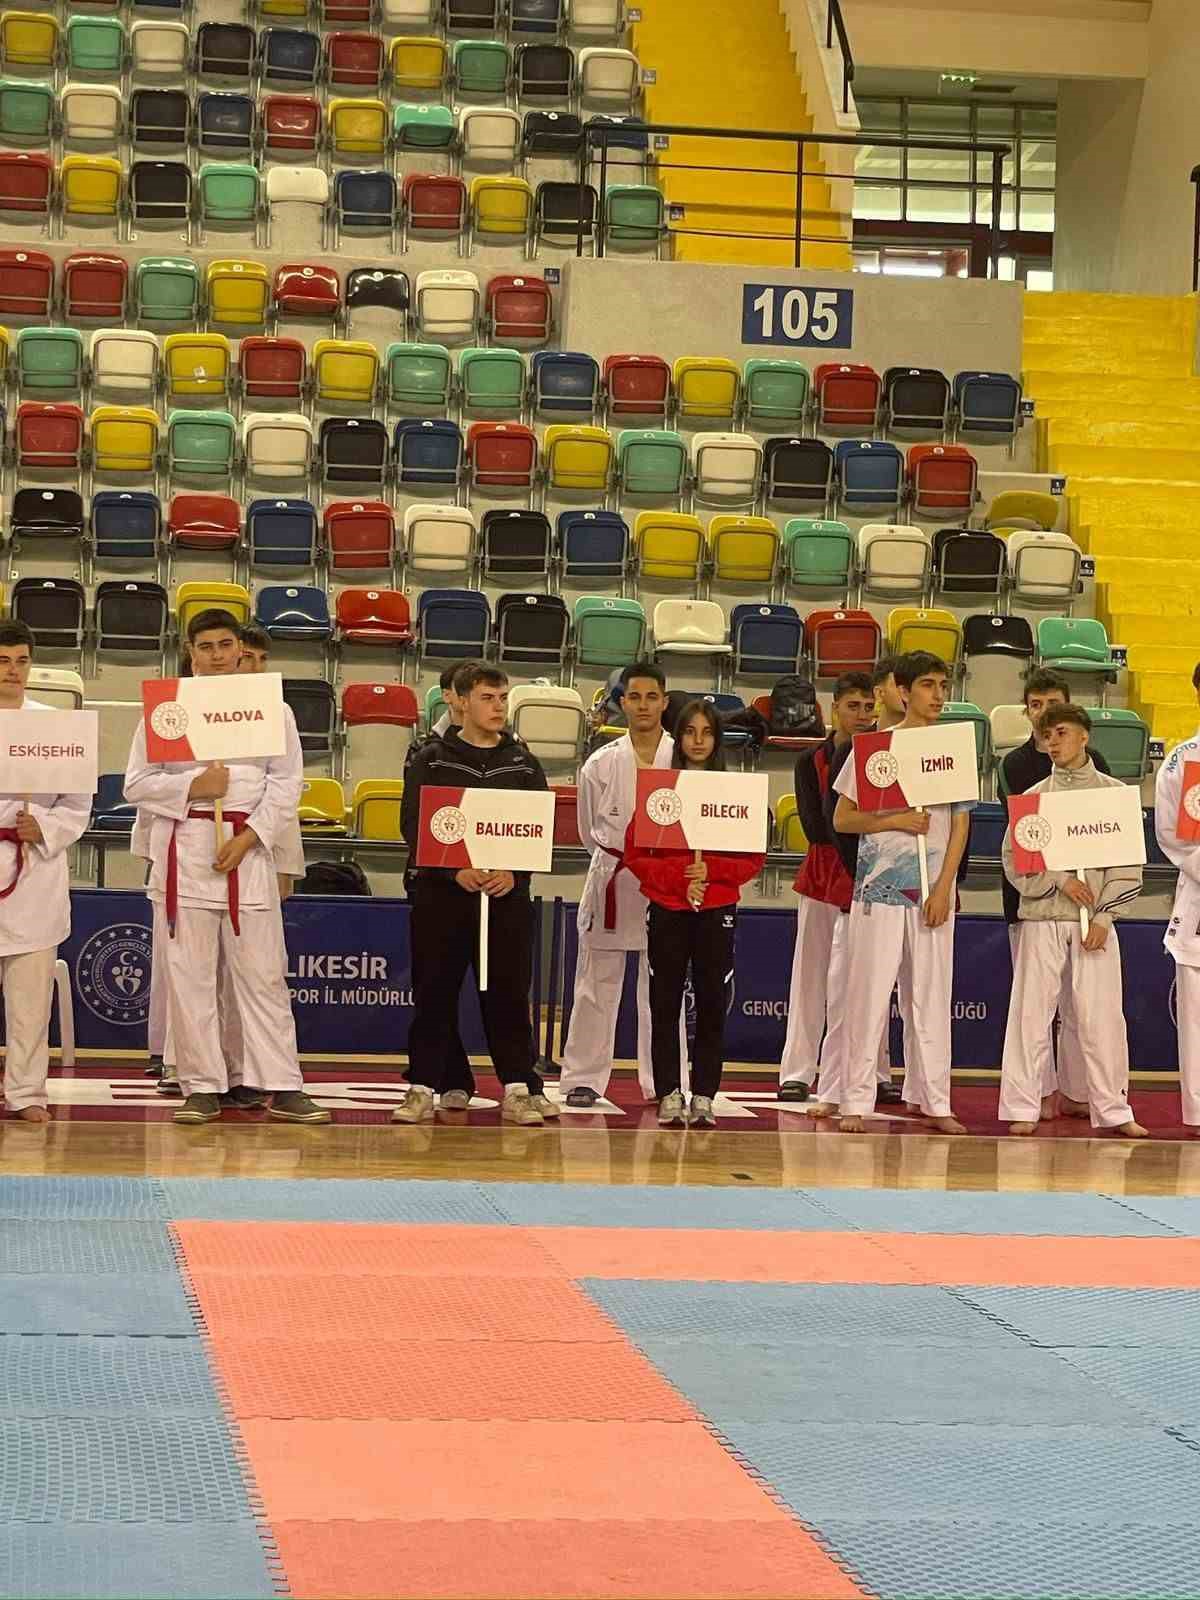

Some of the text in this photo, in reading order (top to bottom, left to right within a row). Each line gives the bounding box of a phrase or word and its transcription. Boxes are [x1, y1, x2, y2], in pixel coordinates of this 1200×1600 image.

[753, 286, 839, 341] 105
[203, 709, 265, 724] YALOVA
[9, 743, 85, 760] ESKİŞEHİR
[920, 754, 955, 774] İZMİR
[1067, 820, 1121, 837] MANİSA
[324, 986, 338, 1004] İL
[951, 1001, 987, 1020] ÜĞÜ
